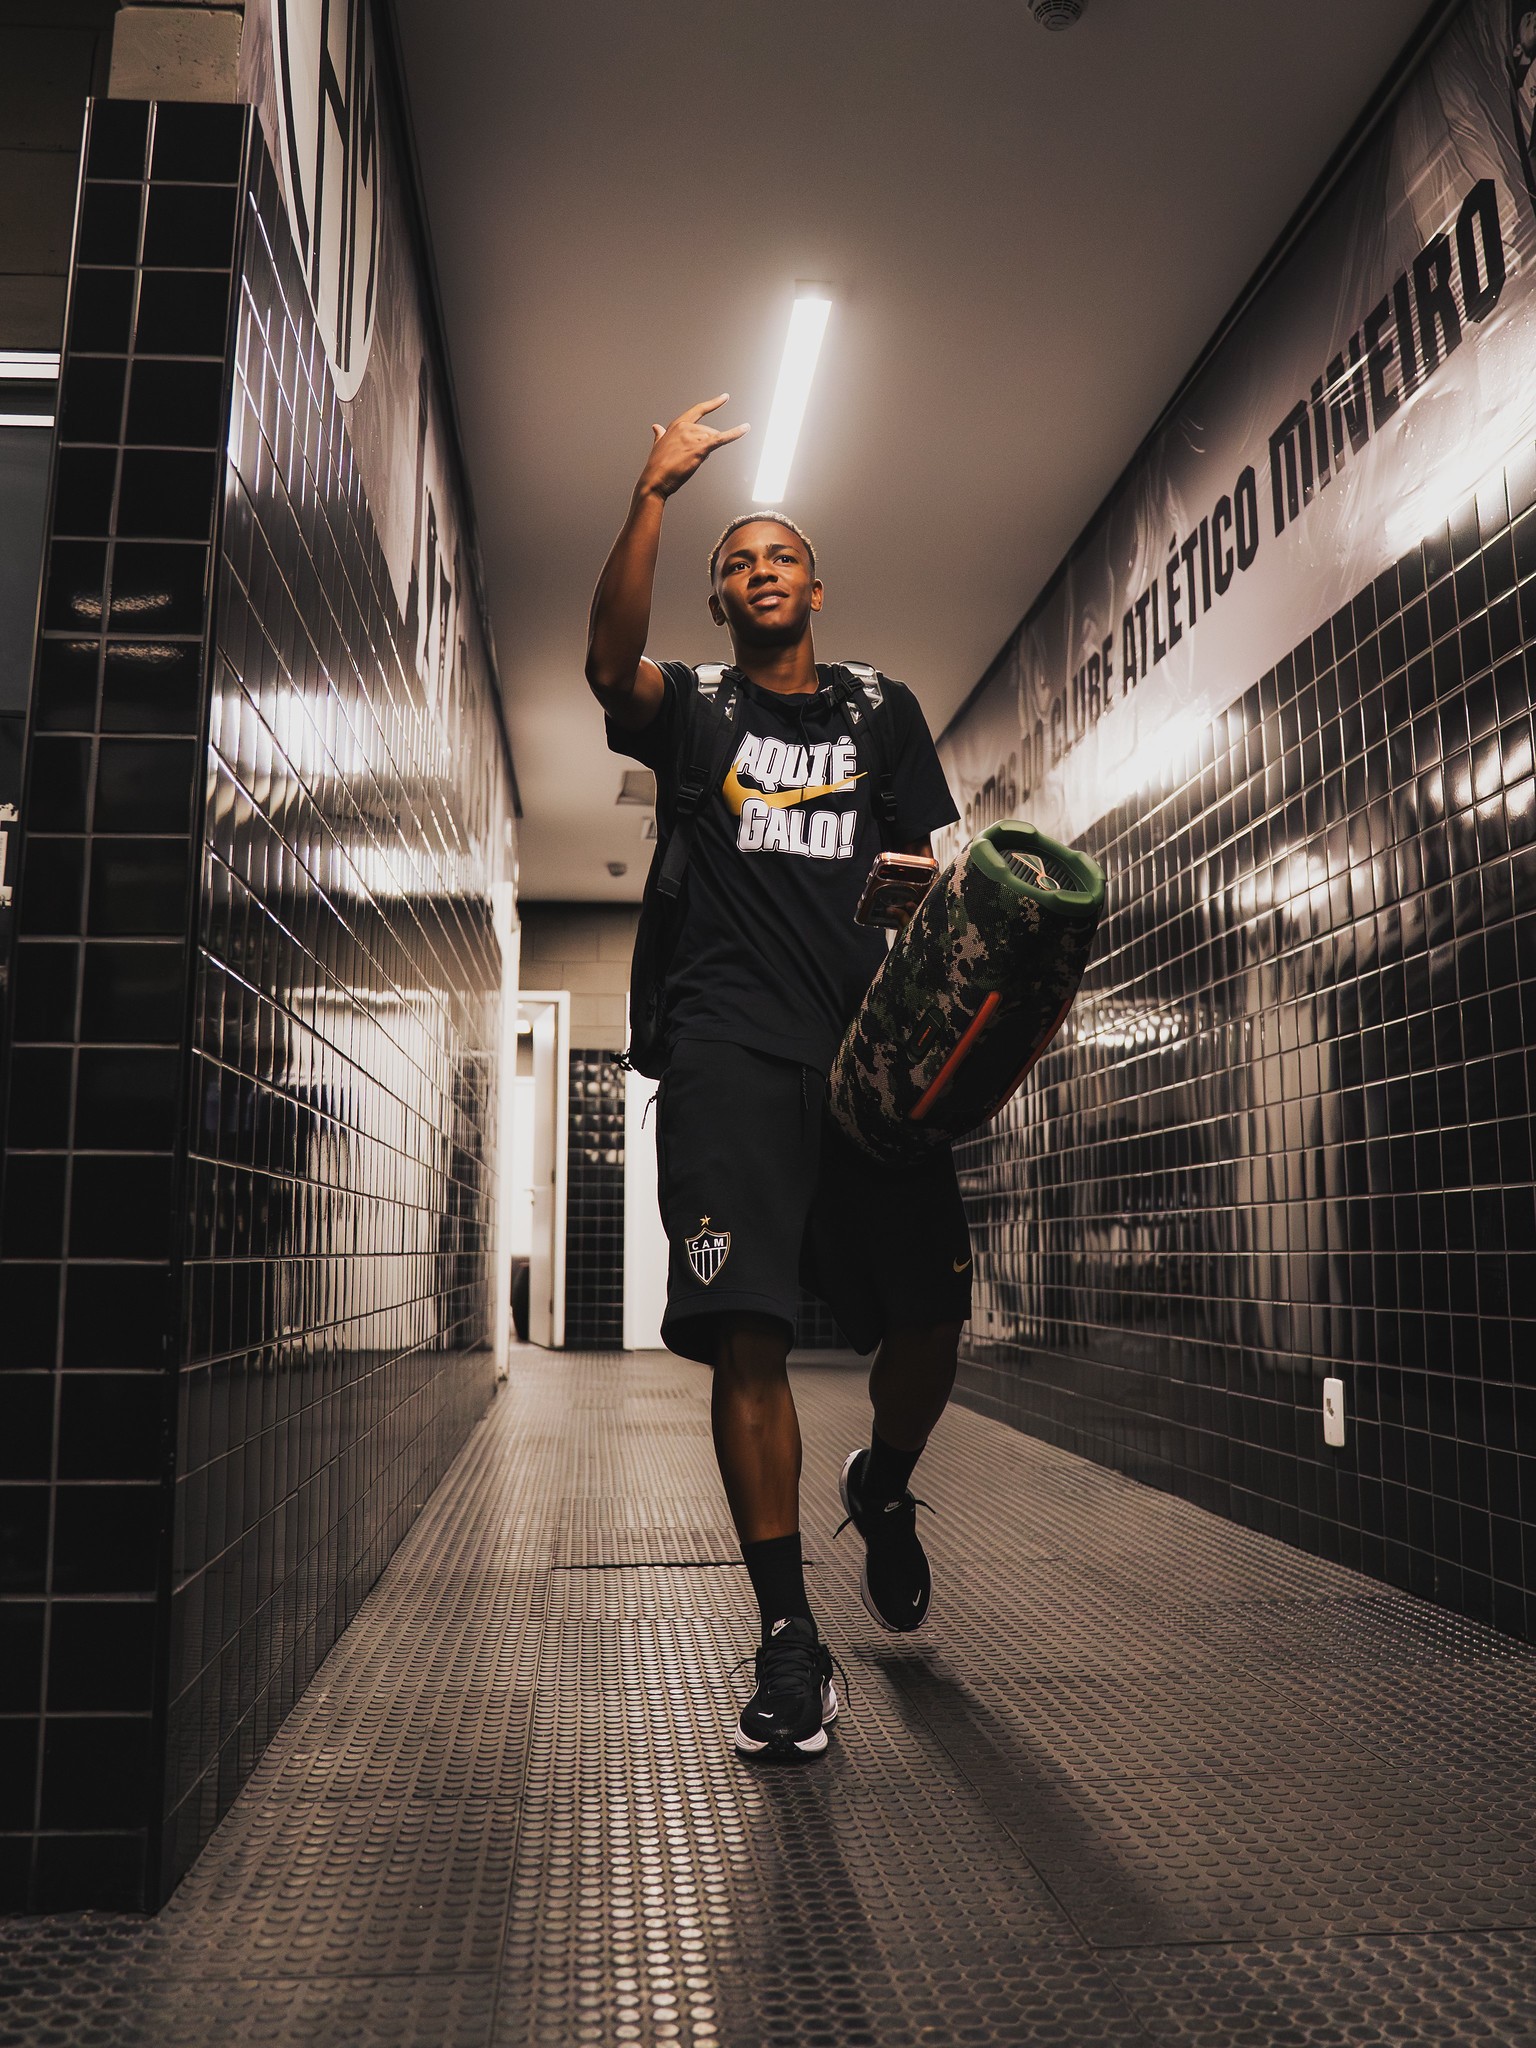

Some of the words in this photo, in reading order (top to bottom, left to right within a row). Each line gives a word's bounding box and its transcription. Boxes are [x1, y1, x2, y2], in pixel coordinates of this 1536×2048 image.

[1051, 631, 1113, 769] CLUBE
[1122, 464, 1260, 698] ATLÉTICO
[1269, 179, 1506, 538] MINEIRO
[732, 731, 831, 793] AQUI
[737, 797, 858, 859] GALO!
[691, 1238, 724, 1250] CAM
